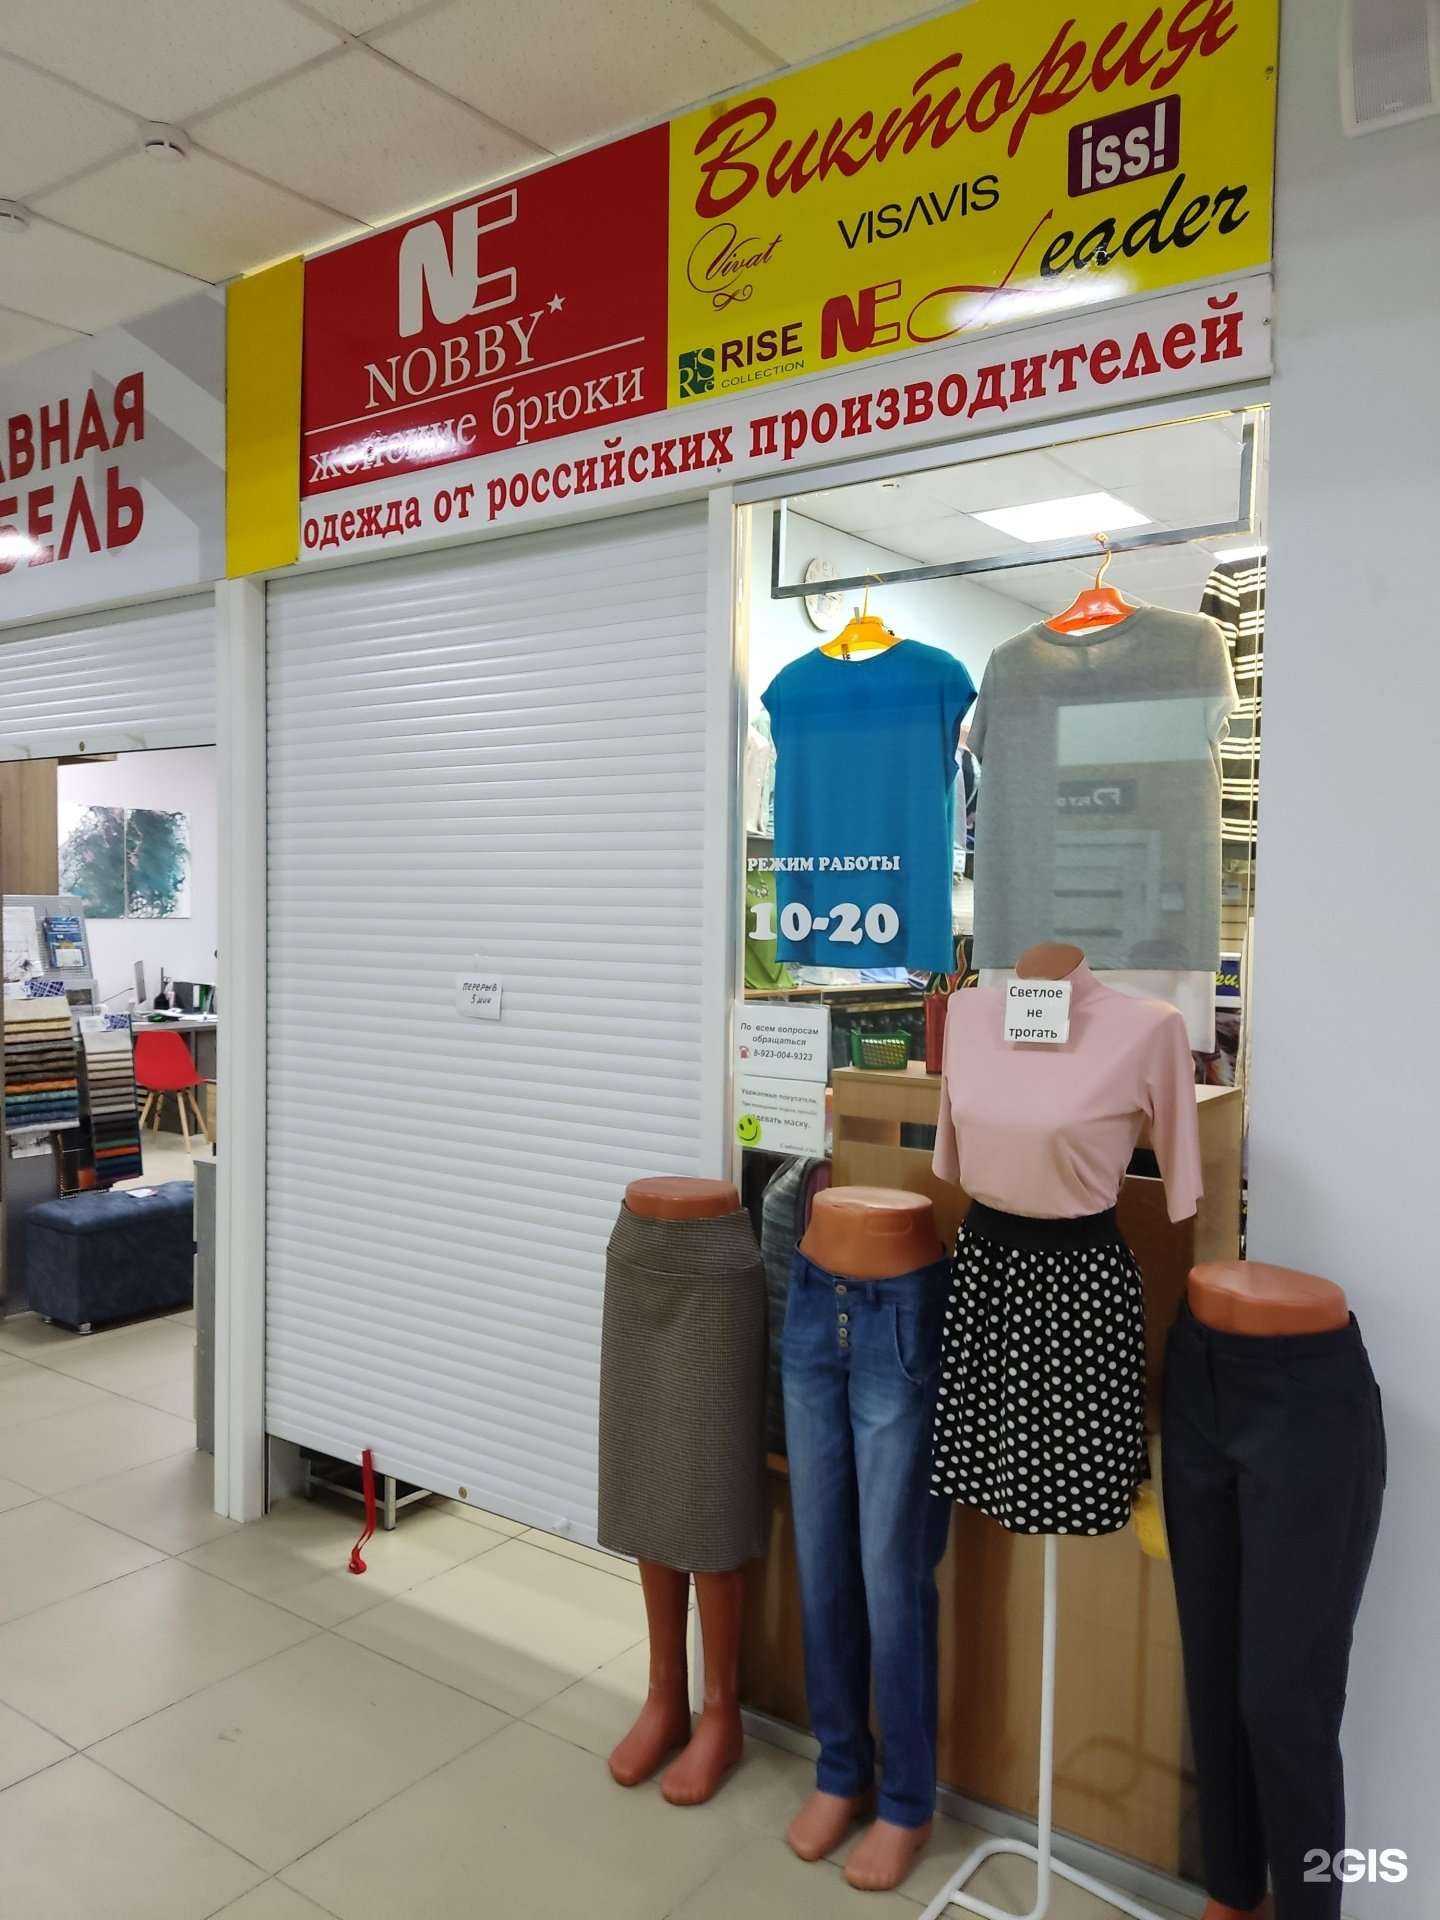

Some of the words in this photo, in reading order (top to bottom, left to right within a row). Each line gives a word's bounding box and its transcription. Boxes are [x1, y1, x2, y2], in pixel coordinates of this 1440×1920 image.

[694, 0, 1239, 219] Виктория
[1080, 101, 1167, 189] iss!
[687, 222, 783, 293] Vivat
[363, 308, 545, 410] NOBBY
[721, 321, 803, 373] RISE
[720, 359, 806, 389] COLLECTION
[0, 371, 145, 482] ВНАЯ
[303, 496, 422, 551] одежда
[433, 482, 476, 524] от
[486, 425, 734, 521] российских
[748, 291, 1245, 461] производителей
[492, 365, 645, 445] брюки
[747, 857, 814, 872] РЕЖИМ
[818, 855, 901, 871] РАБОТЫ
[748, 902, 900, 945] 10-20
[1009, 986, 1064, 999] Светлое
[1026, 1008, 1043, 1018] не
[740, 1022, 752, 1031] По
[755, 1024, 776, 1032] всем
[777, 1026, 819, 1035] вопросам
[752, 1035, 807, 1046] обращаться
[1008, 1028, 1058, 1039] трогать
[753, 1048, 813, 1061] 8-923-004-9323
